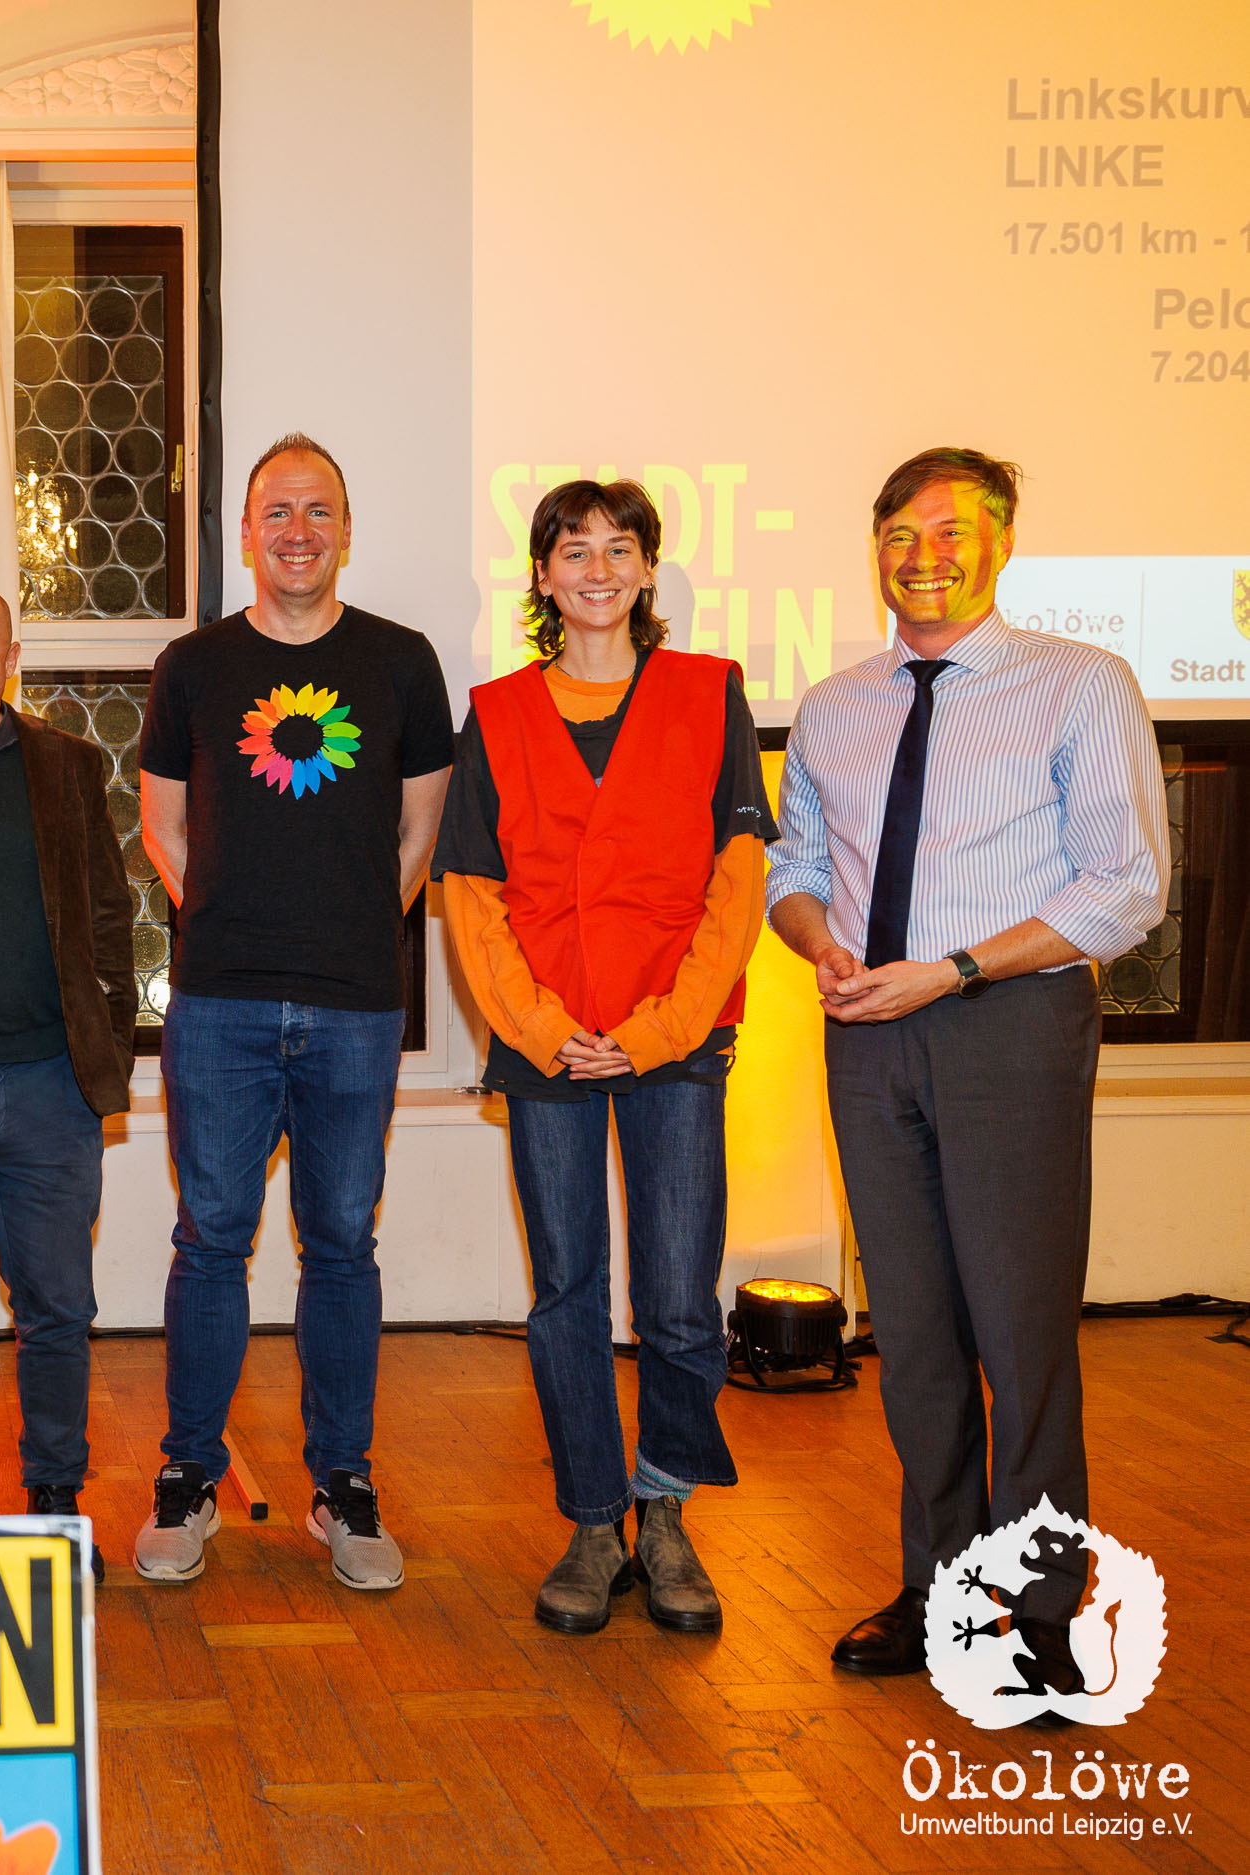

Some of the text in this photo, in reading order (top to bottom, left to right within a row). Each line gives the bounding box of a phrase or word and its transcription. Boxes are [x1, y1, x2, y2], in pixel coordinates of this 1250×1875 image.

[1006, 145, 1164, 187] LINKE
[1003, 221, 1124, 255] 17.501
[1140, 221, 1198, 254] km
[1150, 350, 1250, 384] 7.204
[1170, 658, 1246, 683] Stadt
